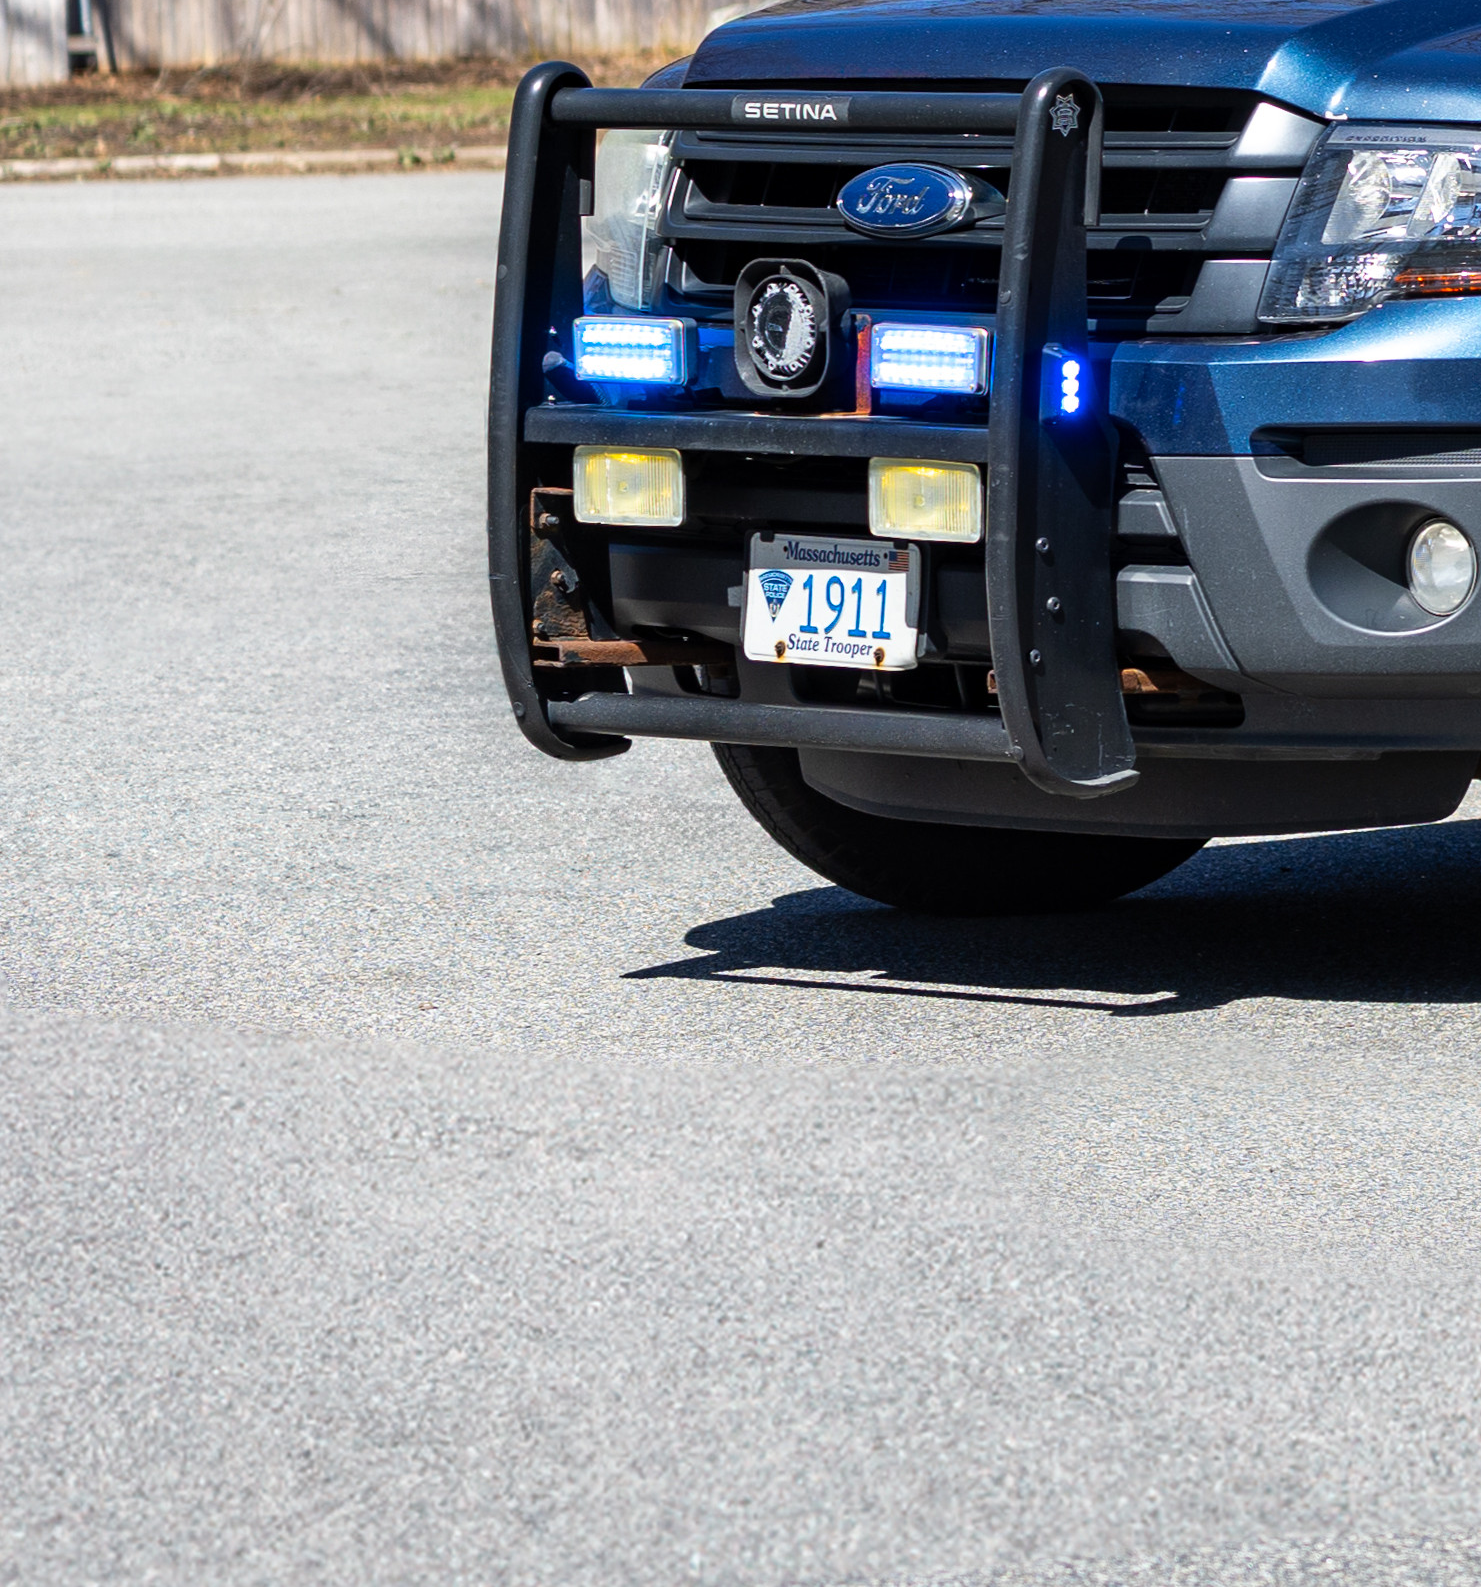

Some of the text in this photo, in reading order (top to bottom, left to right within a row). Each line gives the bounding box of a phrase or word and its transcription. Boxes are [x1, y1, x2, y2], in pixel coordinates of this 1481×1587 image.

[744, 102, 837, 121] SETINA
[856, 176, 930, 215] Ford
[786, 541, 881, 567] Massachusetts
[763, 582, 788, 593] STATE
[800, 574, 891, 639] 1911
[787, 633, 873, 658] State Trooper
